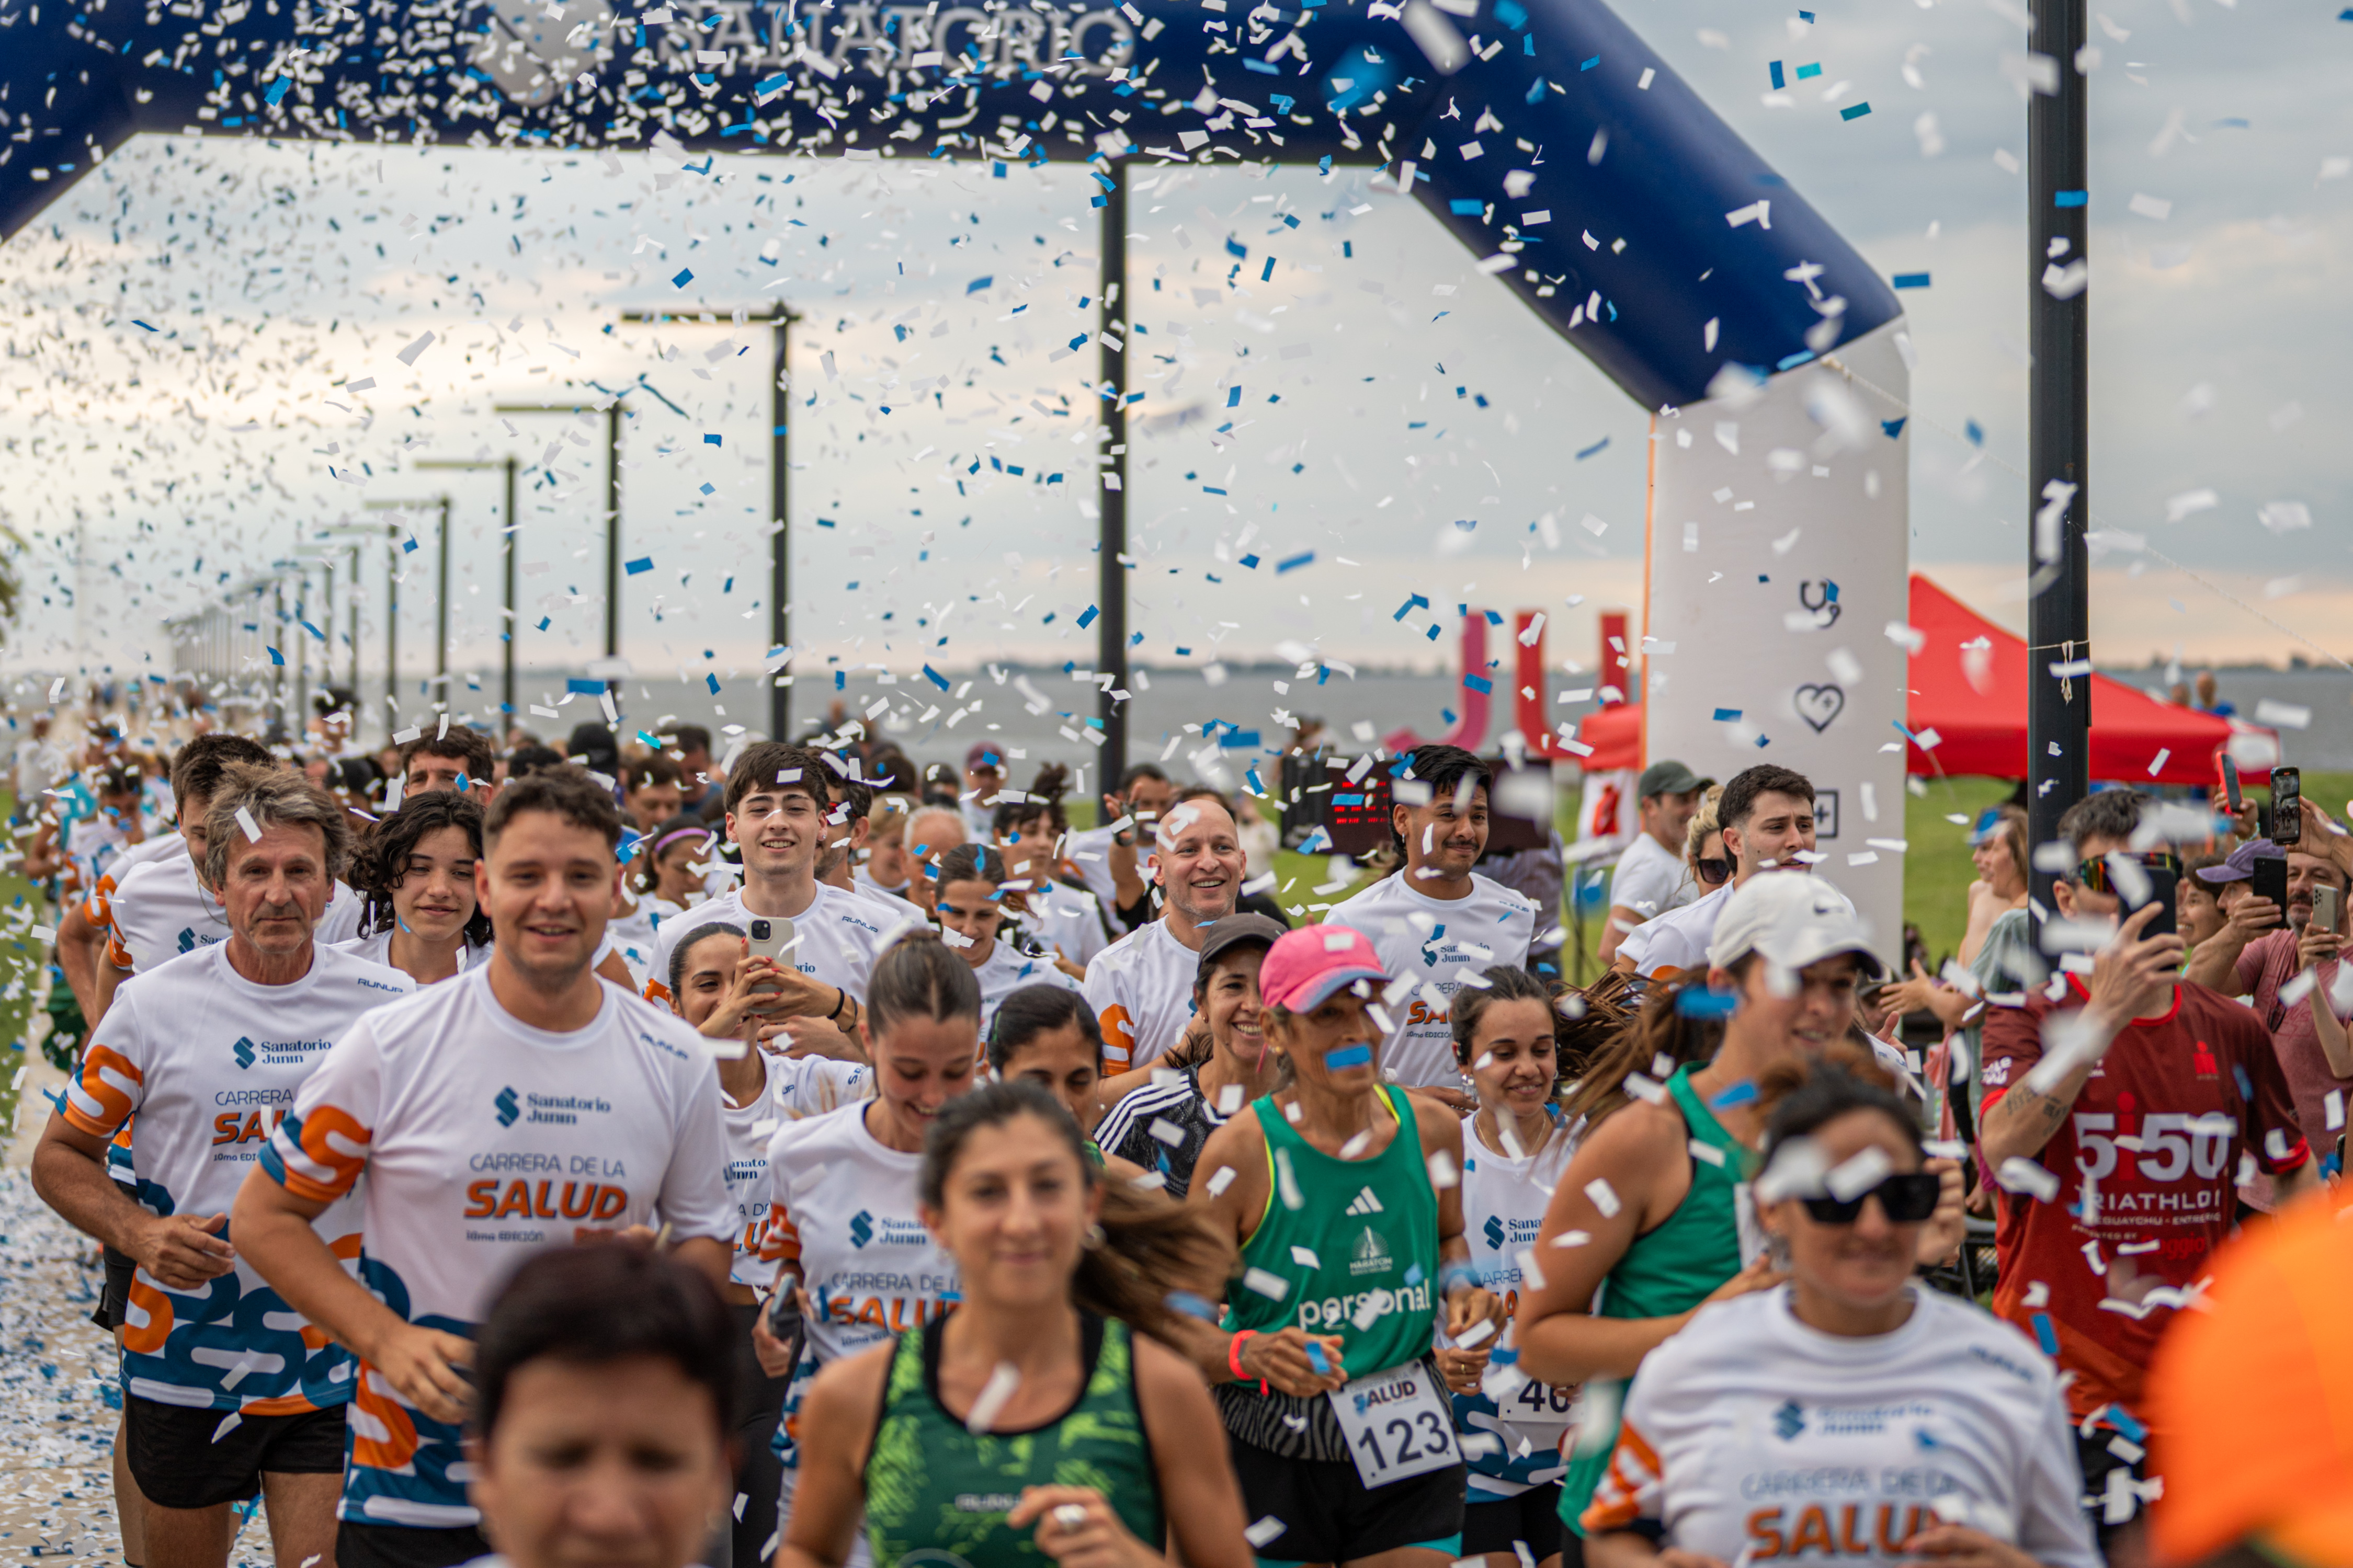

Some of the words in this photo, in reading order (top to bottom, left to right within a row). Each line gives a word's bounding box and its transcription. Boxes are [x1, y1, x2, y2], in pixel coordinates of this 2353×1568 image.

[842, 916, 878, 933] RUNUP
[358, 978, 403, 992] RUNUP
[261, 1038, 332, 1052] Sanatorio
[215, 1089, 294, 1106] CARRERA
[527, 1092, 611, 1114] Sanatorio
[470, 1153, 562, 1173] CARRERA
[570, 1155, 597, 1177] DE
[603, 1158, 626, 1177] LA
[463, 1177, 628, 1222] SALUD
[2074, 1183, 2221, 1211] RIATHLO
[920, 1274, 945, 1294] DE
[1358, 1410, 1449, 1470] 123
